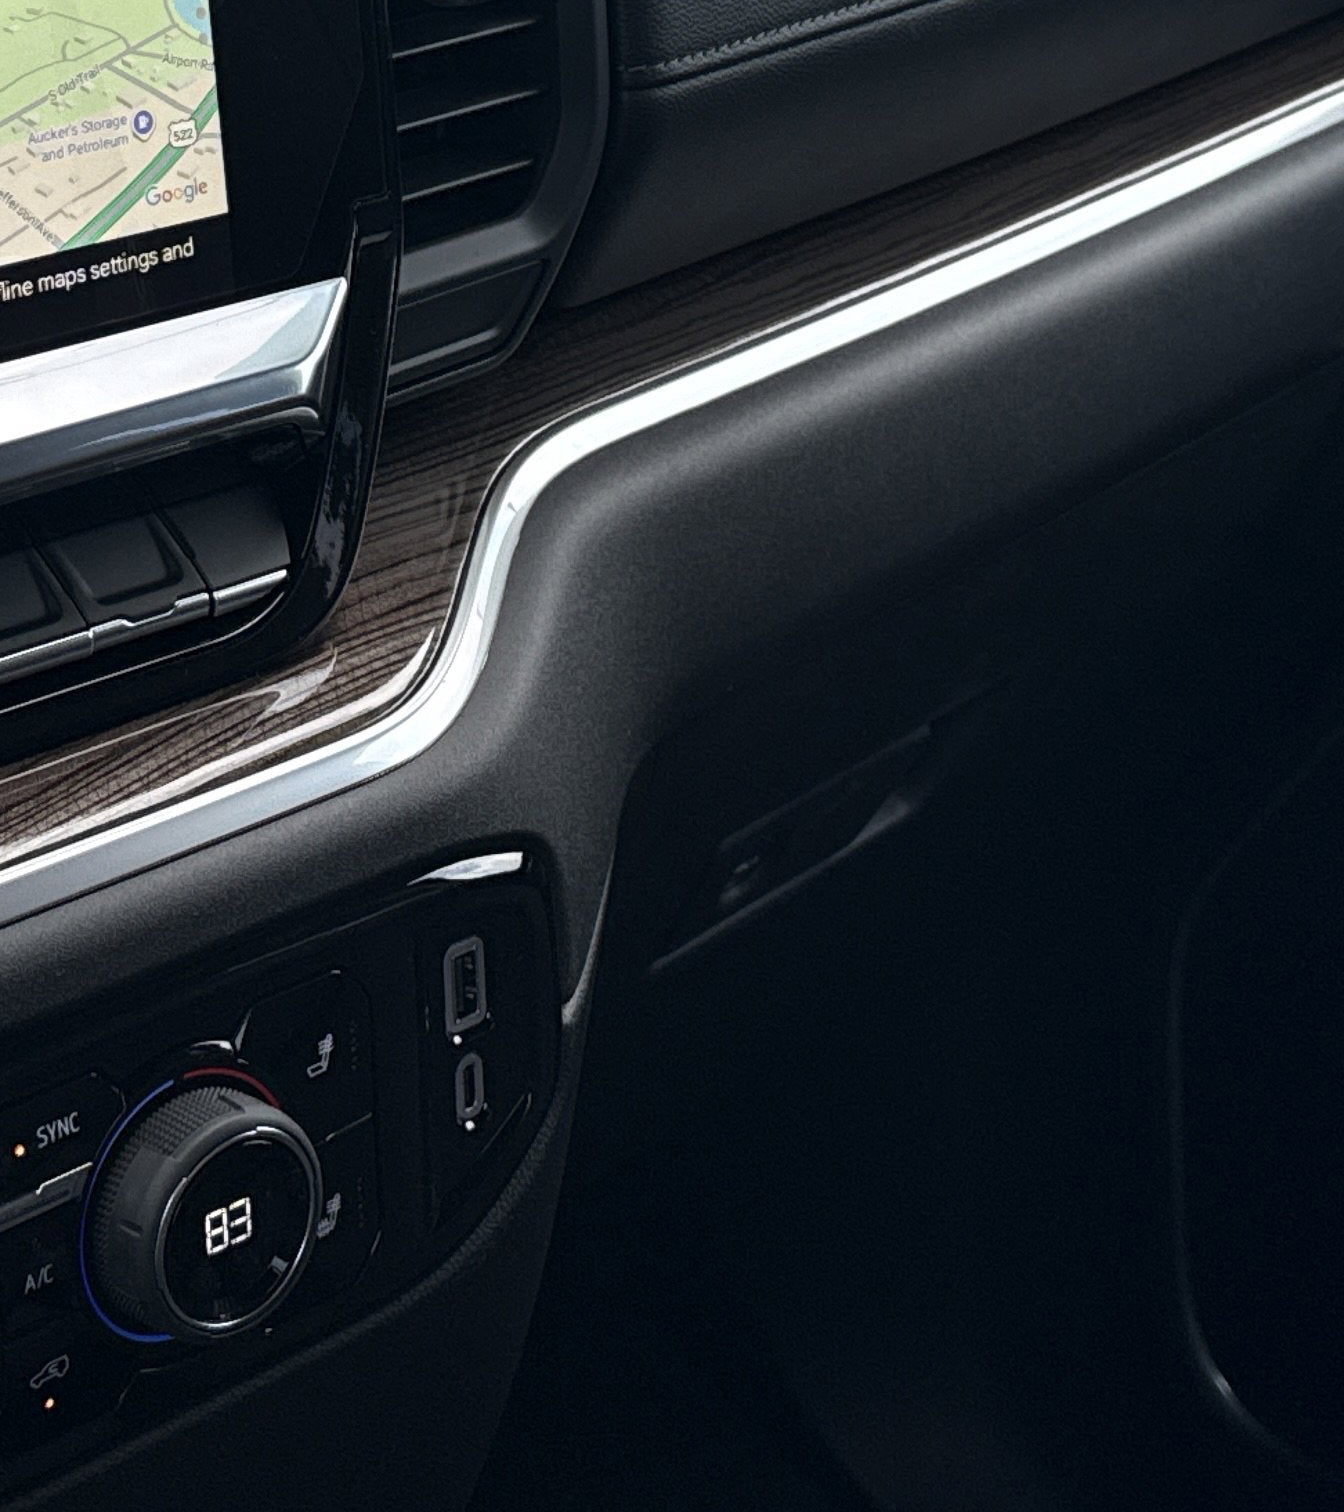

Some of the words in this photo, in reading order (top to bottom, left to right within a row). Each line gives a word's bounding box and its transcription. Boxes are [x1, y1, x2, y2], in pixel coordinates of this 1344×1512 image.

[80, 114, 128, 134] Storage
[173, 127, 194, 142] 522
[41, 146, 65, 162] and
[67, 135, 130, 156] Petroleum
[145, 177, 208, 206] Google
[38, 267, 87, 294] maps
[90, 251, 159, 281] settings
[162, 236, 195, 263] and
[36, 1112, 81, 1150] SYNC
[205, 1196, 254, 1256] 83
[24, 1263, 54, 1295] A/C
